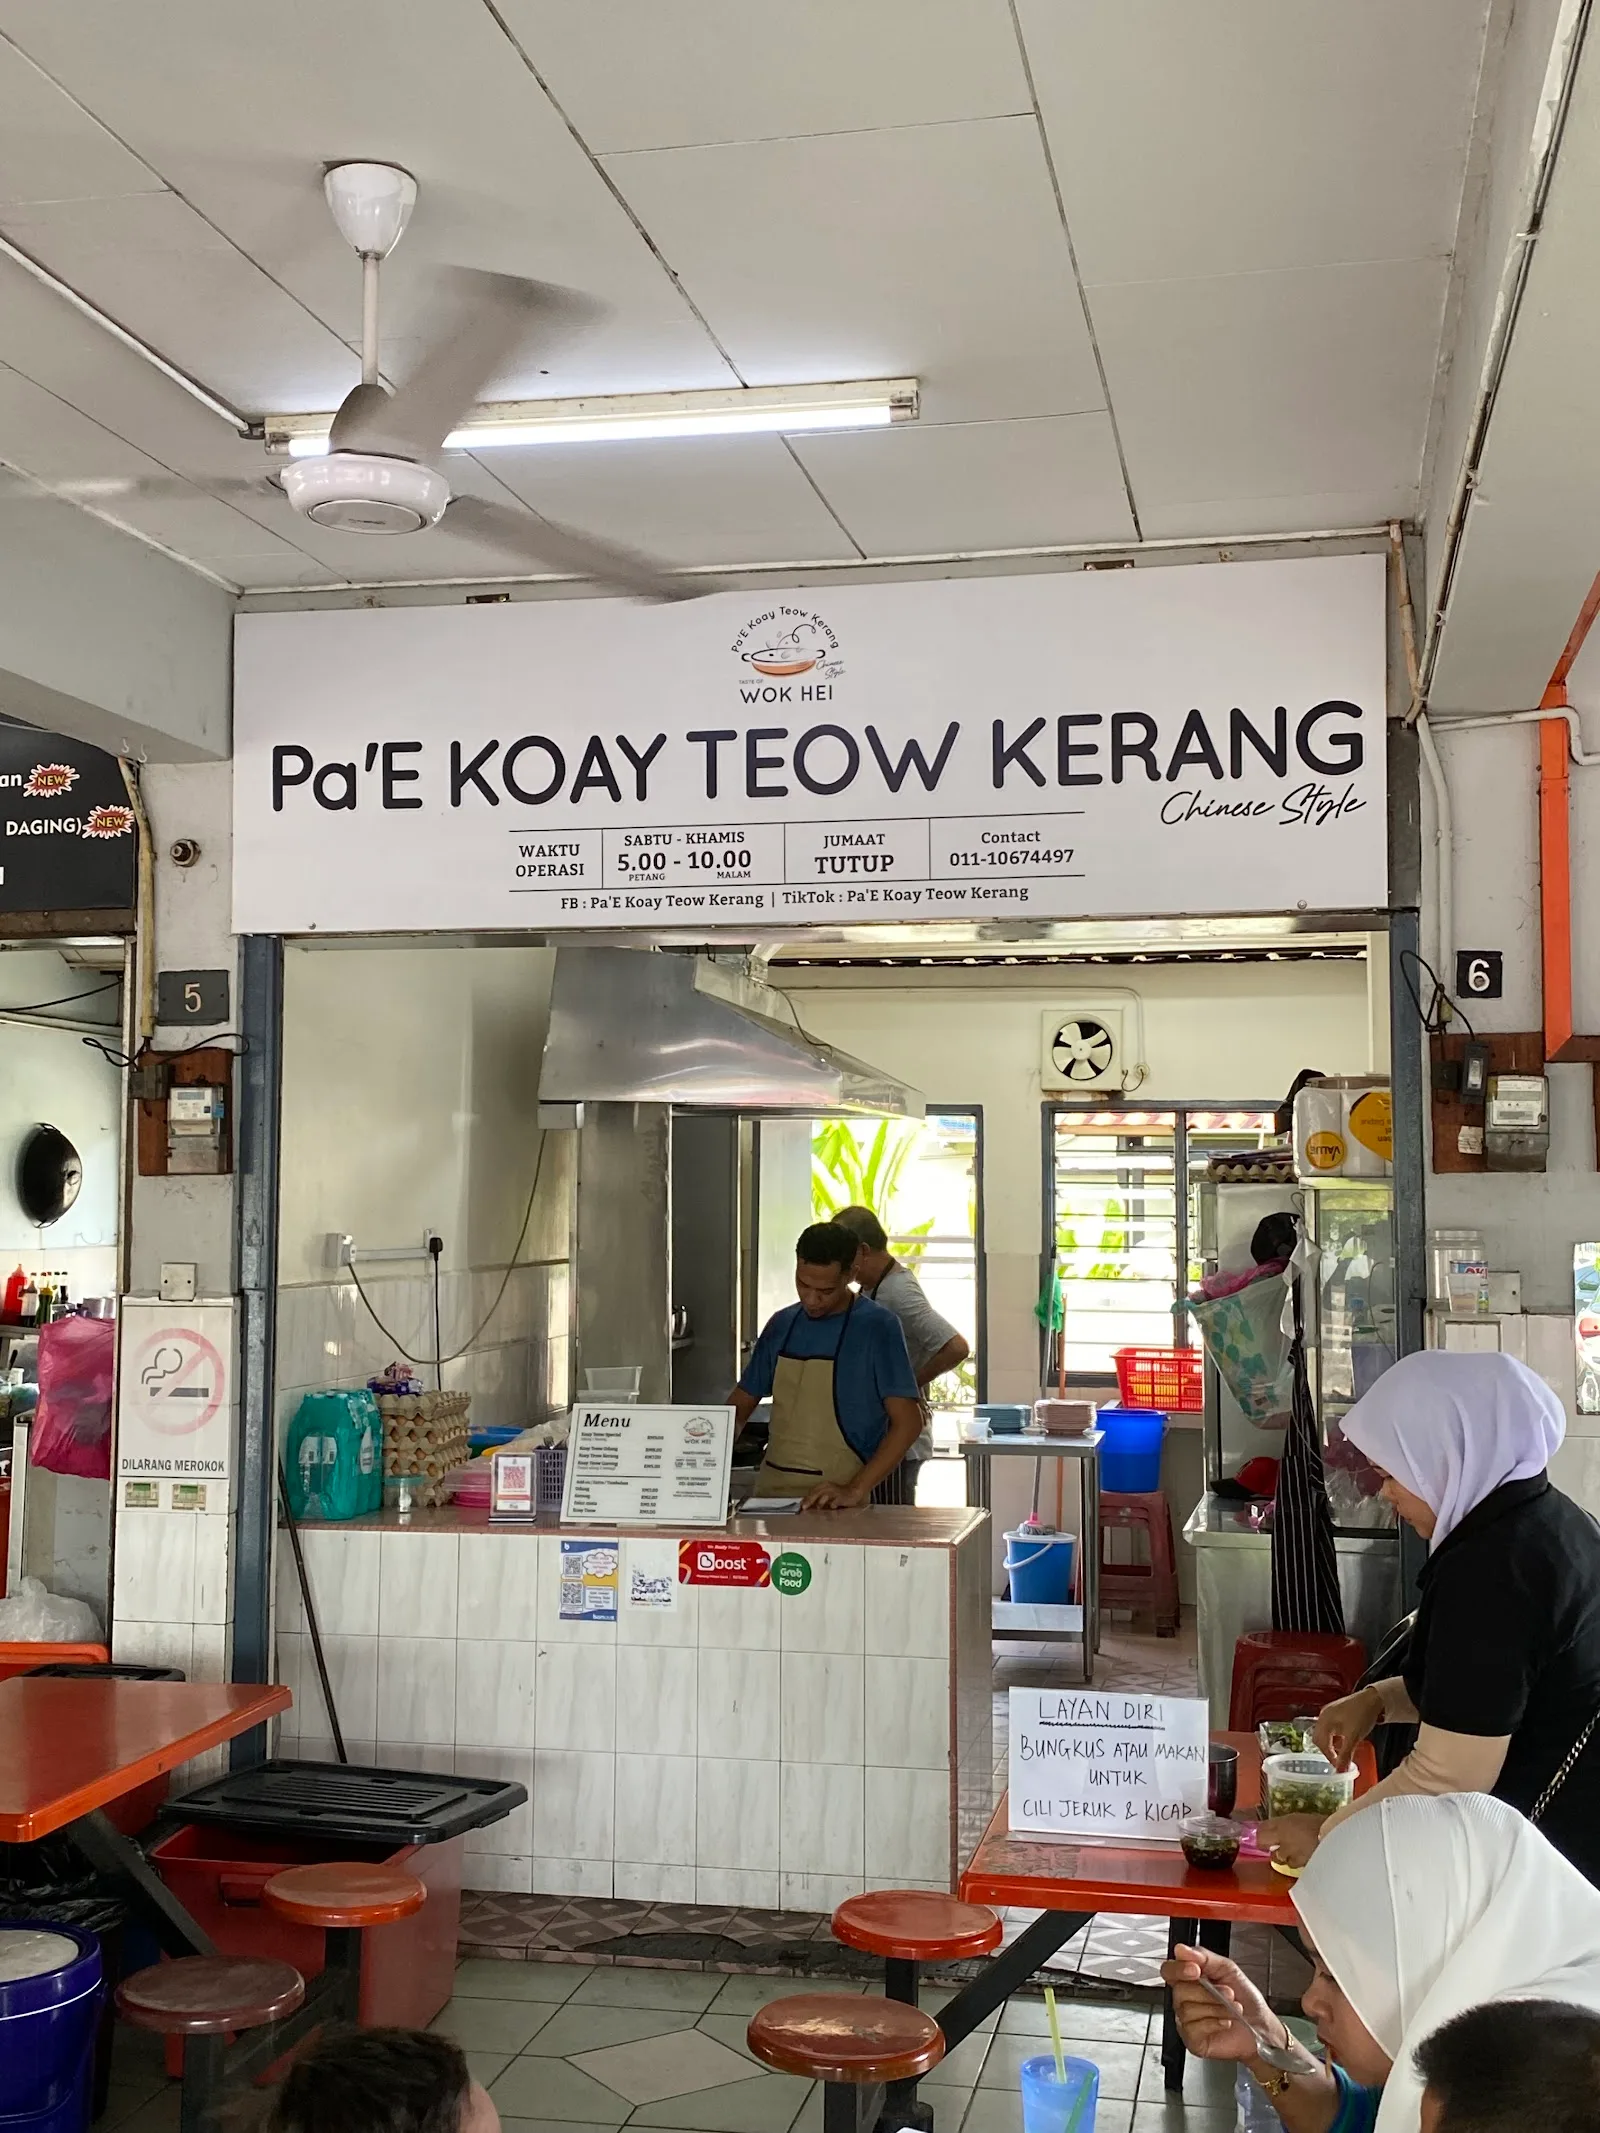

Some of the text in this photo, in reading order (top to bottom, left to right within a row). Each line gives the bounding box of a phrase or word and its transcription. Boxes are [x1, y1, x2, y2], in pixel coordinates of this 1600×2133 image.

[731, 606, 839, 653] Pa'E Koay Teow Kerang
[740, 685, 832, 704] WOK HEI
[272, 700, 1363, 812] Pa'E KOAY TEOW KERANG
[37, 774, 66, 786] NEW
[1161, 783, 1367, 826] Chinese Style
[6, 817, 82, 835] DAGING)
[96, 816, 125, 828] NEW
[624, 833, 673, 847] SABTU
[686, 831, 745, 845] KHAMIS
[823, 834, 885, 847] JUMAAT
[981, 830, 1041, 844] Contact
[518, 844, 580, 858] WAKTU
[950, 849, 1074, 866] 011-10674497
[617, 852, 666, 871] 5.00
[687, 850, 751, 869] 10.00
[814, 855, 894, 874] TUTUP
[516, 863, 584, 877] OPERASI
[628, 873, 665, 882] PETANG
[717, 870, 751, 879] MALAM
[561, 898, 578, 909] FB
[590, 896, 621, 909] Pa'E
[625, 895, 662, 911] Koay
[665, 895, 705, 907] Teow
[708, 893, 764, 909] Kerang
[782, 890, 835, 904] TikTok
[847, 888, 879, 902] Pa'E
[883, 888, 922, 904] Koay
[925, 887, 967, 900] Teow
[971, 885, 1029, 902] Kerang
[1468, 958, 1490, 992] 6
[184, 983, 202, 1013] 5
[583, 1413, 631, 1428] Menu
[122, 1458, 225, 1472] DILARANG MEROKOK
[780, 1568, 802, 1577] Grab
[779, 1577, 802, 1588] Food
[1039, 1697, 1163, 1721] LAYAN DIRI
[1020, 1733, 1205, 1763] BUNGKUS ATAU MAKAN
[1089, 1769, 1147, 1787] UNTUK
[1023, 1799, 1192, 1822] CILI JERUK & KICAP
